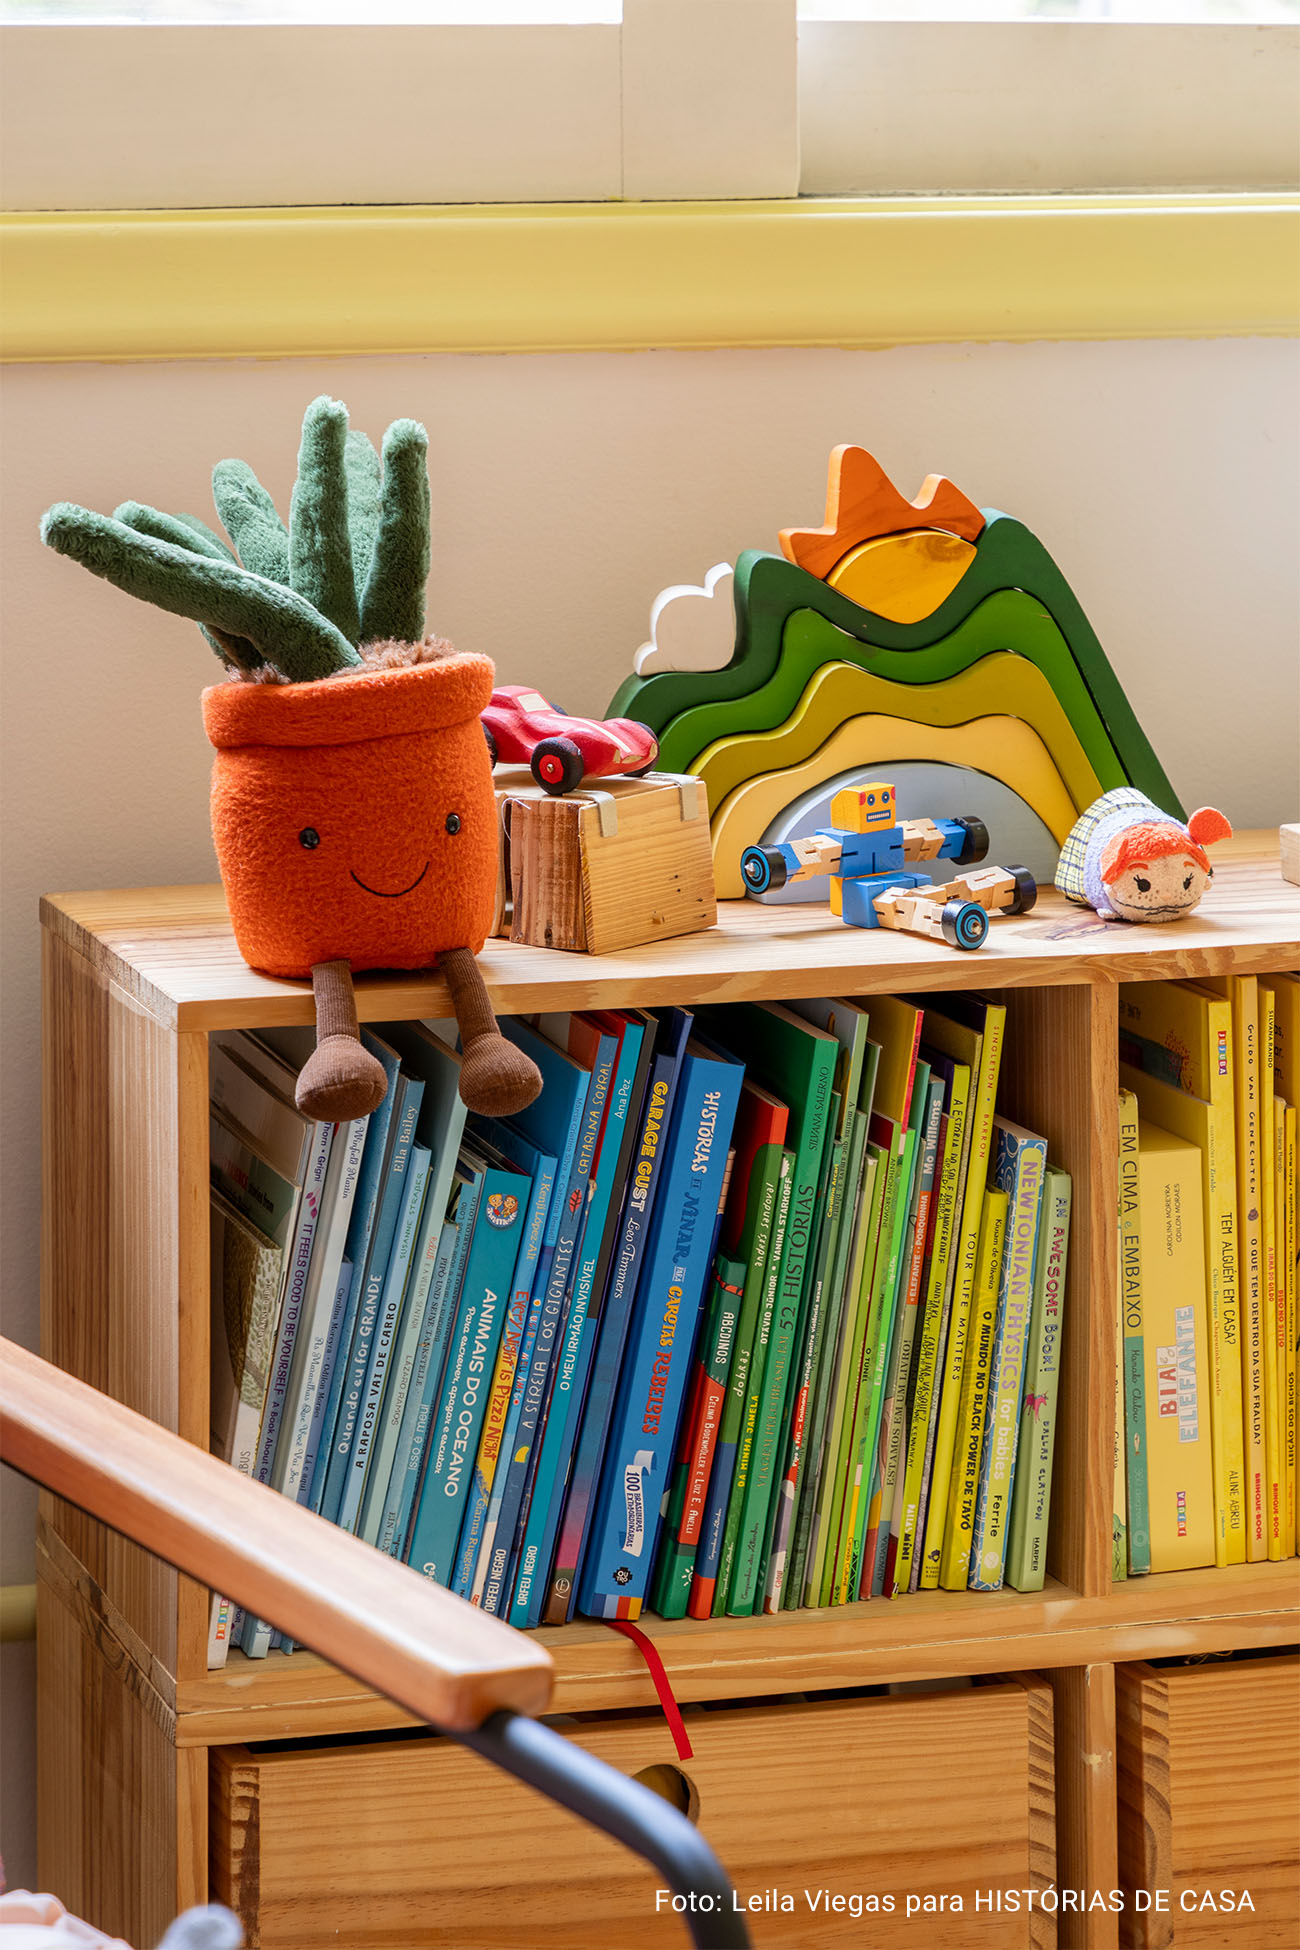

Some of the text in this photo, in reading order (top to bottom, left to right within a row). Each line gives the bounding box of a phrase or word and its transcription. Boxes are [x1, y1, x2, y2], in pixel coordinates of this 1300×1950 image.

[1218, 1031, 1228, 1075] JUJUBA
[614, 1079, 631, 1119] Ana Pez
[809, 1067, 830, 1150] SILVANA SALERNO
[979, 1026, 999, 1158] SINGLETON BARRON
[393, 1105, 417, 1173] Ella Bailey
[578, 1111, 600, 1174] CATARINA
[691, 1091, 721, 1173] HISTÓRIAS
[927, 1100, 941, 1149] Willems
[614, 1081, 668, 1299] GARAGE GUST Leo Timmers
[923, 1156, 934, 1174] Mo
[761, 1182, 774, 1228] sandoval
[1122, 1124, 1142, 1328] EM CIMA e EMBAIXO
[545, 1237, 574, 1315] GIGANTES
[760, 1178, 792, 1344] OTÁVIO JÚNIOR VANINA STARKOFF
[780, 1184, 815, 1331] 52 HISTÓRIAS
[910, 1194, 928, 1297] ELEFANTE PORQUINHA
[988, 1218, 1002, 1289] Kiusam de Oliveira
[1250, 1249, 1258, 1271] QUE
[272, 1223, 314, 1395] IT FEELS GOOD TO BE YOURSELF
[952, 1232, 977, 1380] YOUR LIFE MATTERS
[1040, 1197, 1068, 1373] AN AWESOME BOOK!
[1221, 1212, 1237, 1345] TEM ALGUÉM EM CASA?
[1250, 1276, 1258, 1298] TEM
[463, 1306, 475, 1333] Para
[542, 1320, 555, 1338] OS
[560, 1259, 595, 1390] O MEU IRMÃO INVISÍVEL
[660, 1285, 682, 1347] GAROTAS
[716, 1312, 734, 1364] ABCDINOS
[994, 1161, 1039, 1481] NEWTONIAN PHYSICS for babies
[1251, 1303, 1259, 1347] DENTRO
[338, 1274, 382, 1455] Quando eu for GRANDE
[355, 1302, 397, 1468] A RAPOSA VAI DE CARRO
[452, 1336, 468, 1385] escrever,
[483, 1290, 529, 1461] Every Night Is Pizza Night
[733, 1350, 750, 1397] dobras
[1132, 1349, 1142, 1384] Hanako
[1176, 1306, 1198, 1440] ELEFANTE
[1252, 1350, 1259, 1366] DA
[1252, 1369, 1261, 1391] SUA
[445, 1288, 497, 1496] ANIMAIS DO OCEANO
[446, 1386, 457, 1425] apagar
[643, 1351, 672, 1435] REBELDES
[706, 1395, 719, 1420] CELINA
[887, 1340, 911, 1486] ESTAMOS EM UM LIVRO!
[960, 1311, 992, 1531] O MUNDO NO BLACK POWER DE TAYÓ
[1159, 1366, 1177, 1416] BIA
[1253, 1394, 1261, 1445] FRALDA?
[265, 1401, 279, 1464] A Book About
[434, 1435, 447, 1474] escutar
[522, 1420, 533, 1429] A
[738, 1395, 759, 1488] DA MINHA JANELA
[693, 1477, 704, 1495] LUIZ
[990, 1495, 1002, 1537] Ferrie
[1176, 1491, 1187, 1537] JUJUBA
[1229, 1471, 1240, 1530] ALINE ABREU
[686, 1510, 698, 1534] ANELLI
[485, 1549, 506, 1611] ORFEU NEGRO
[517, 1546, 537, 1605] ORFEU NEGRO
[1032, 1537, 1040, 1572] HARPER
